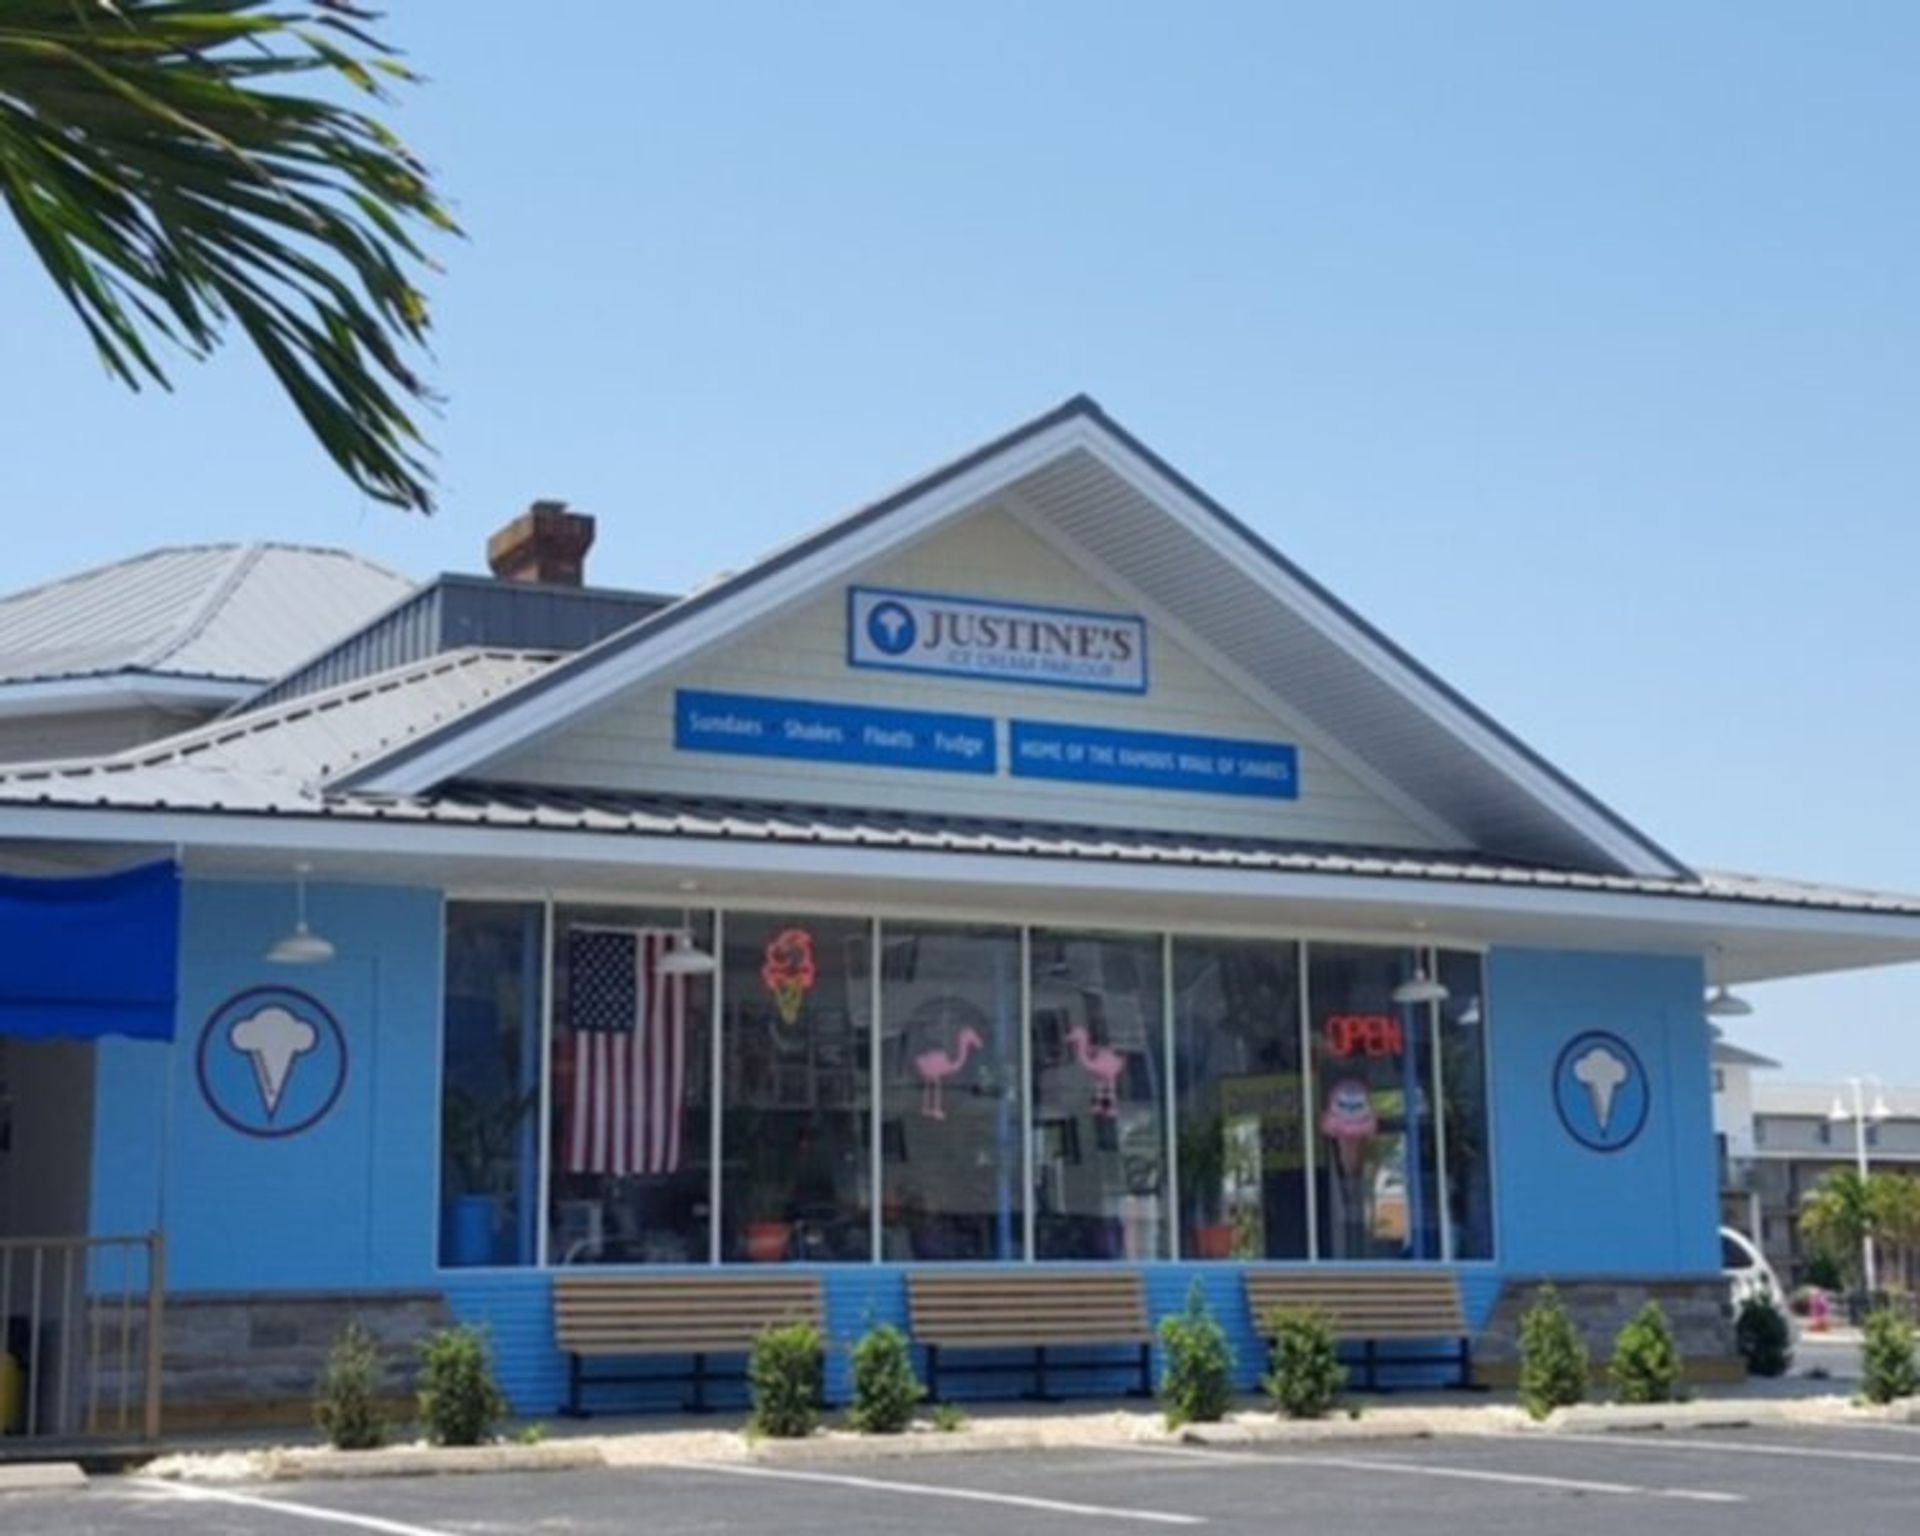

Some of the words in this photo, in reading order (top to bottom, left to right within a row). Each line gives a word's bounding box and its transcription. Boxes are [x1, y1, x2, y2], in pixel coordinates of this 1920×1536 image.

[923, 610, 1133, 661] JUSTINE'S
[689, 711, 762, 736] Sundaes
[783, 717, 842, 743] Shakes
[863, 725, 914, 749] Floats
[934, 731, 984, 758] Fudge
[1020, 740, 1062, 760] HOME
[1065, 742, 1085, 762] OF
[1088, 744, 1114, 765] THE
[1118, 747, 1174, 770] FAMOUS
[1217, 756, 1234, 776] OF
[1327, 1016, 1402, 1057] OPEN
